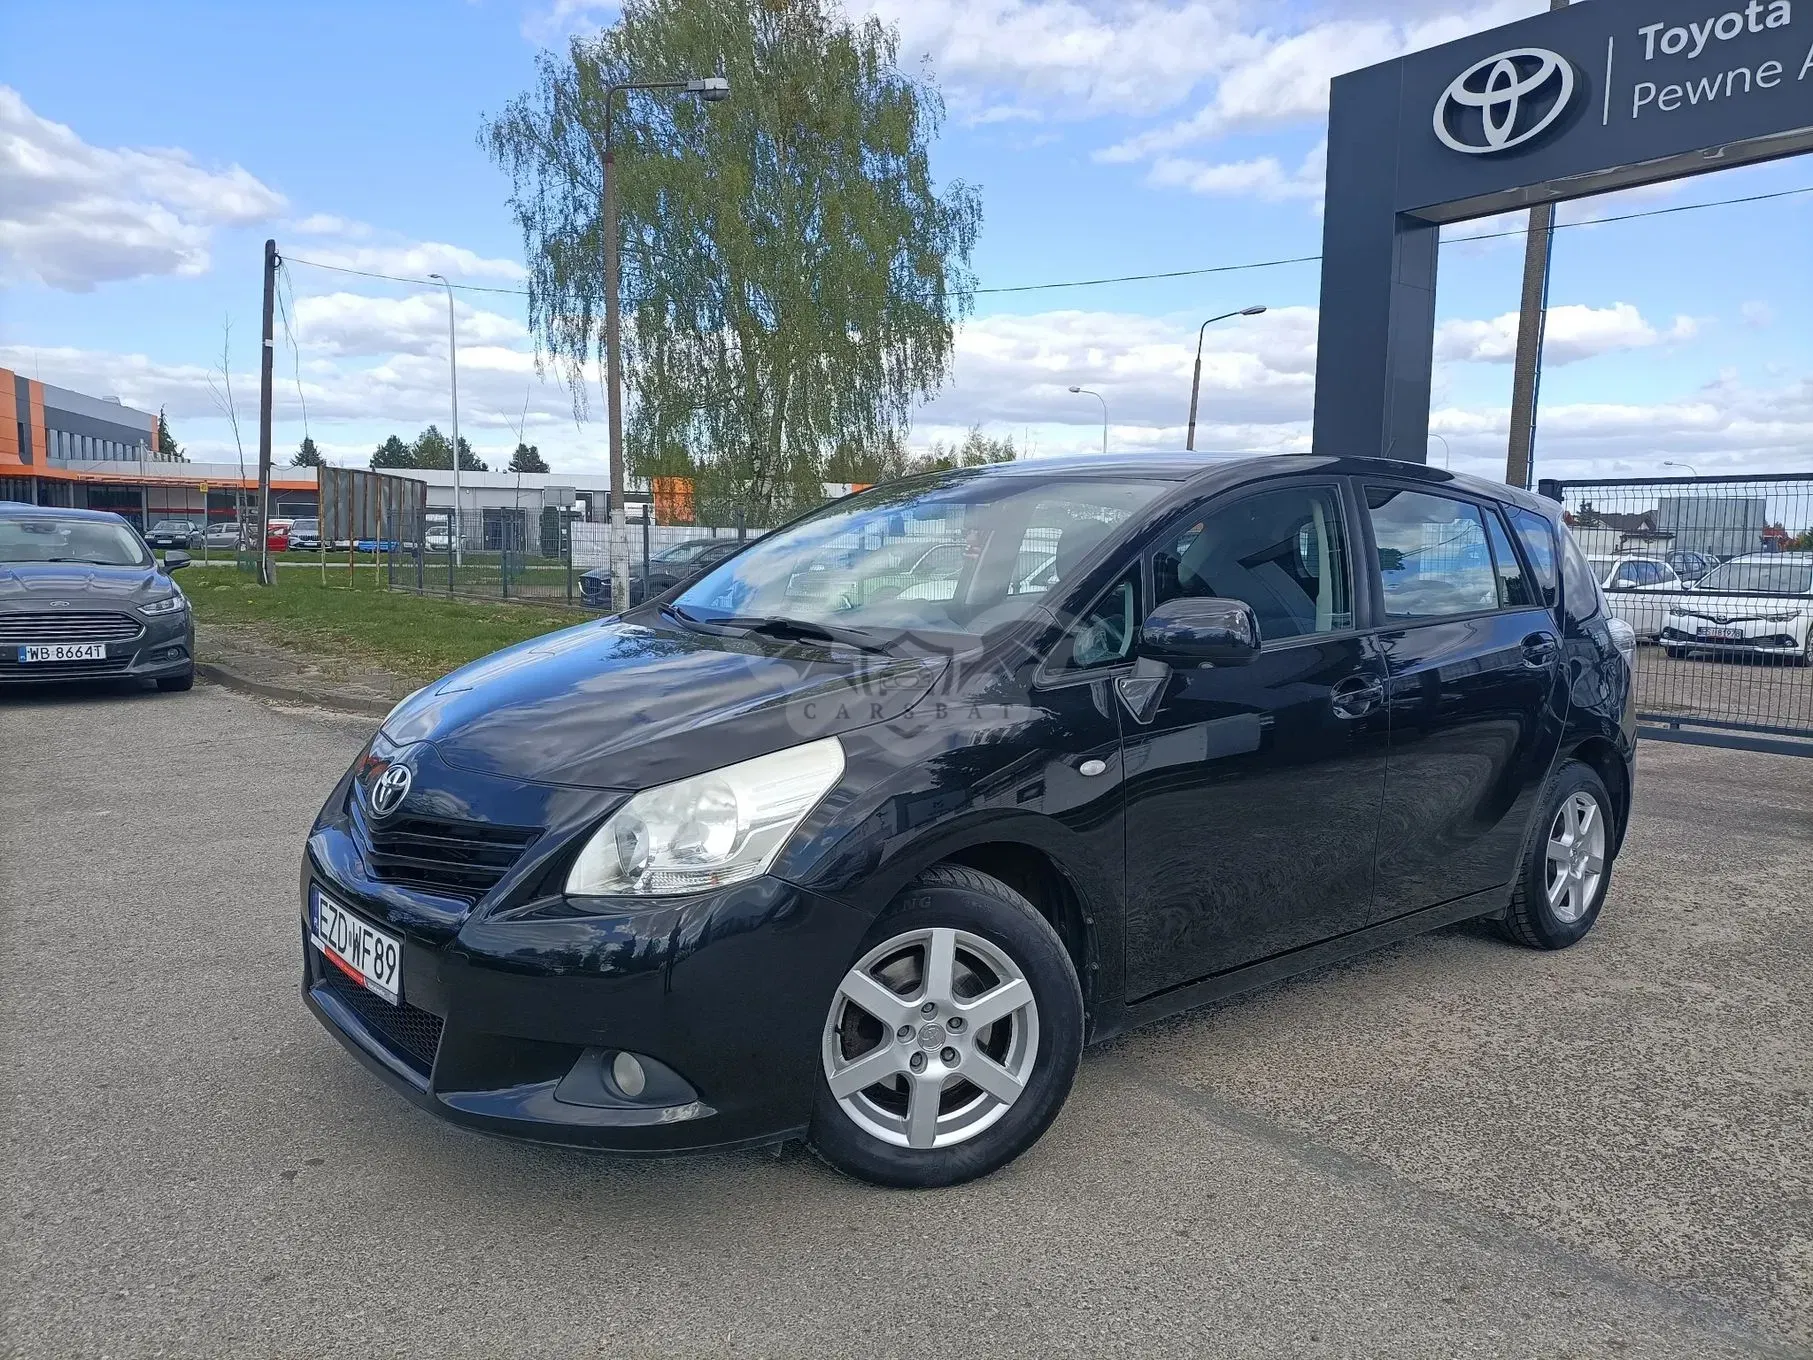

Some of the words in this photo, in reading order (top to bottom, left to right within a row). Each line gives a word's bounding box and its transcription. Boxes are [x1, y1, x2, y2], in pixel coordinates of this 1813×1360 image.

[1638, 0, 1791, 61] Toyota
[1632, 60, 1783, 119] Pewne
[29, 647, 50, 660] WB
[56, 645, 102, 659] 8664T
[320, 897, 348, 954] EZD
[352, 921, 397, 985] WF89
